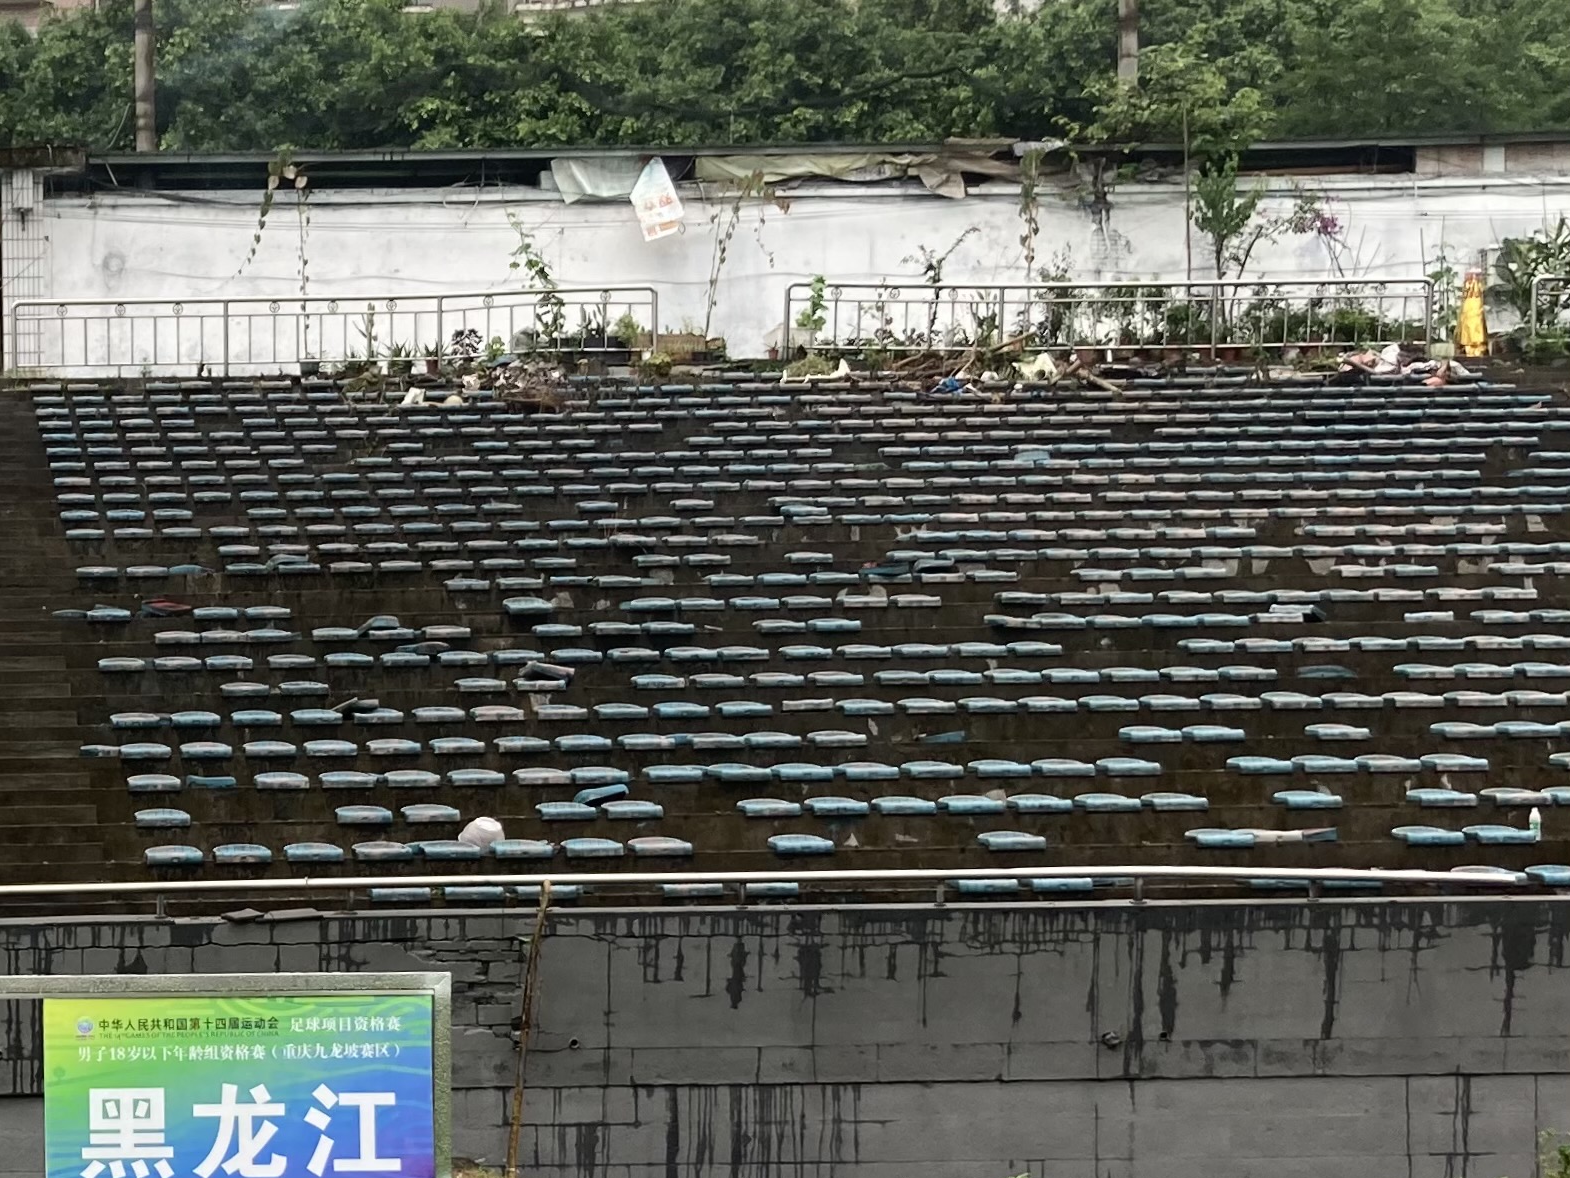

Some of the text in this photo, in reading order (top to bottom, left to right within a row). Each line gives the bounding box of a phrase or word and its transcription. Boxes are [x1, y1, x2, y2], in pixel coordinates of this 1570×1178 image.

[98, 1016, 402, 1032] 中华人民共和国第十四届运动会 足球项目资格赛
